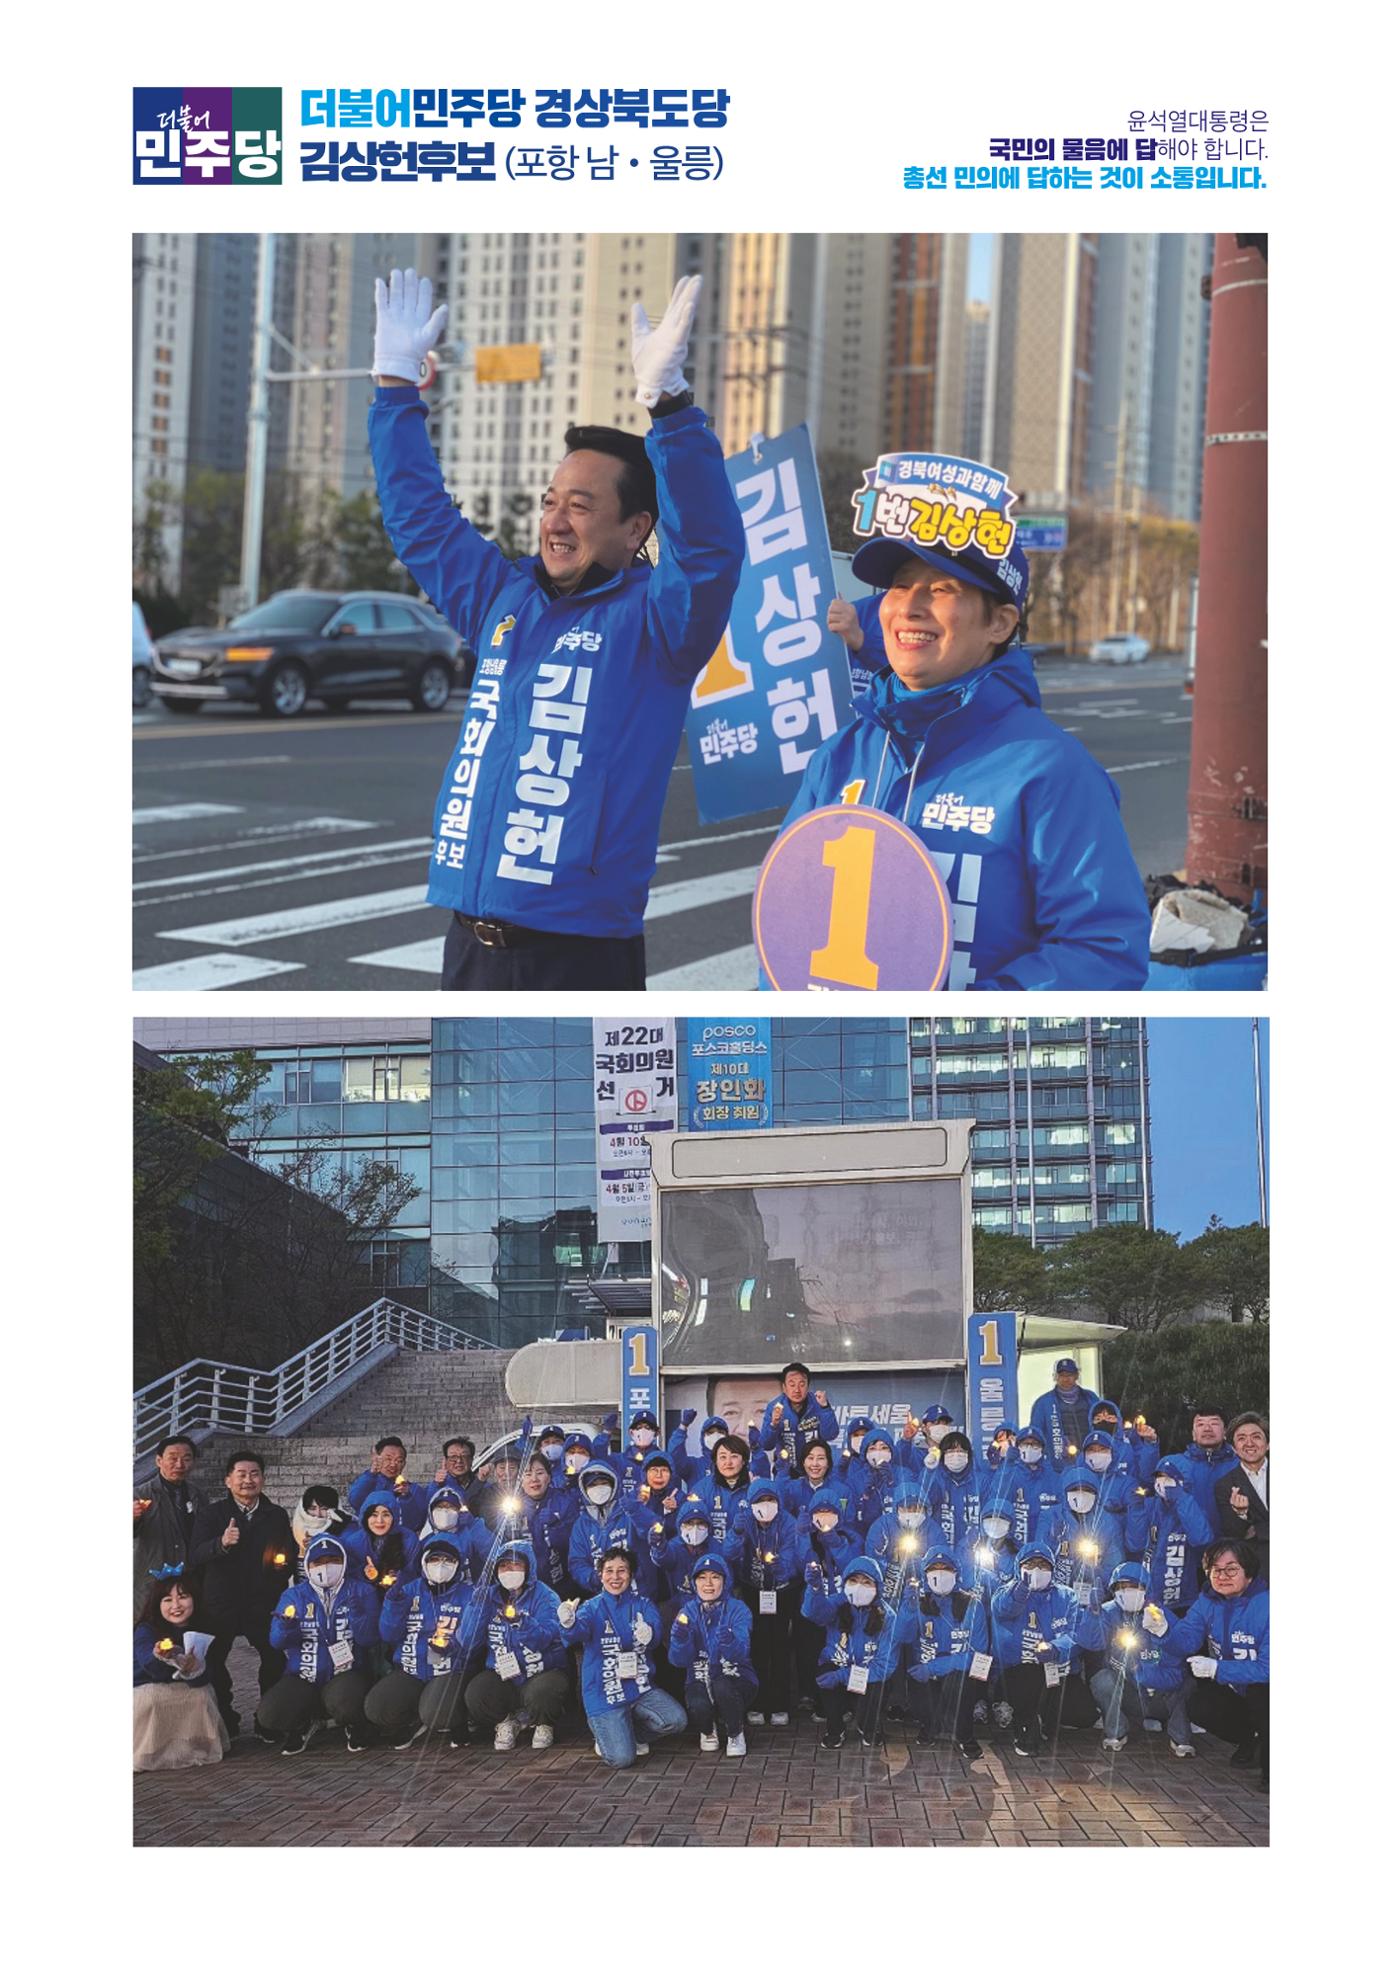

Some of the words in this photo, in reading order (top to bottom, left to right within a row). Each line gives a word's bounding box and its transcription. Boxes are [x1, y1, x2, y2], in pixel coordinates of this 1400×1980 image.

[898, 459, 1004, 500] 경북여성과함께
[735, 457, 839, 775] 김상헌
[440, 678, 501, 841] 국회의원
[699, 722, 759, 766] 민주당
[496, 663, 594, 886] 김상헌
[921, 802, 996, 835] 민주당
[809, 825, 880, 991] 1
[604, 1026, 664, 1047] 제22대
[691, 1041, 768, 1057] 포스코홀딩스
[702, 1024, 757, 1042] posco
[595, 1048, 674, 1074] 국회의원
[710, 1062, 751, 1076] 제10대
[695, 1079, 767, 1104] 장인화
[702, 1107, 730, 1121] 회장
[733, 1105, 760, 1121] 취임
[629, 1333, 650, 1377] 1
[979, 1320, 1003, 1366] 1
